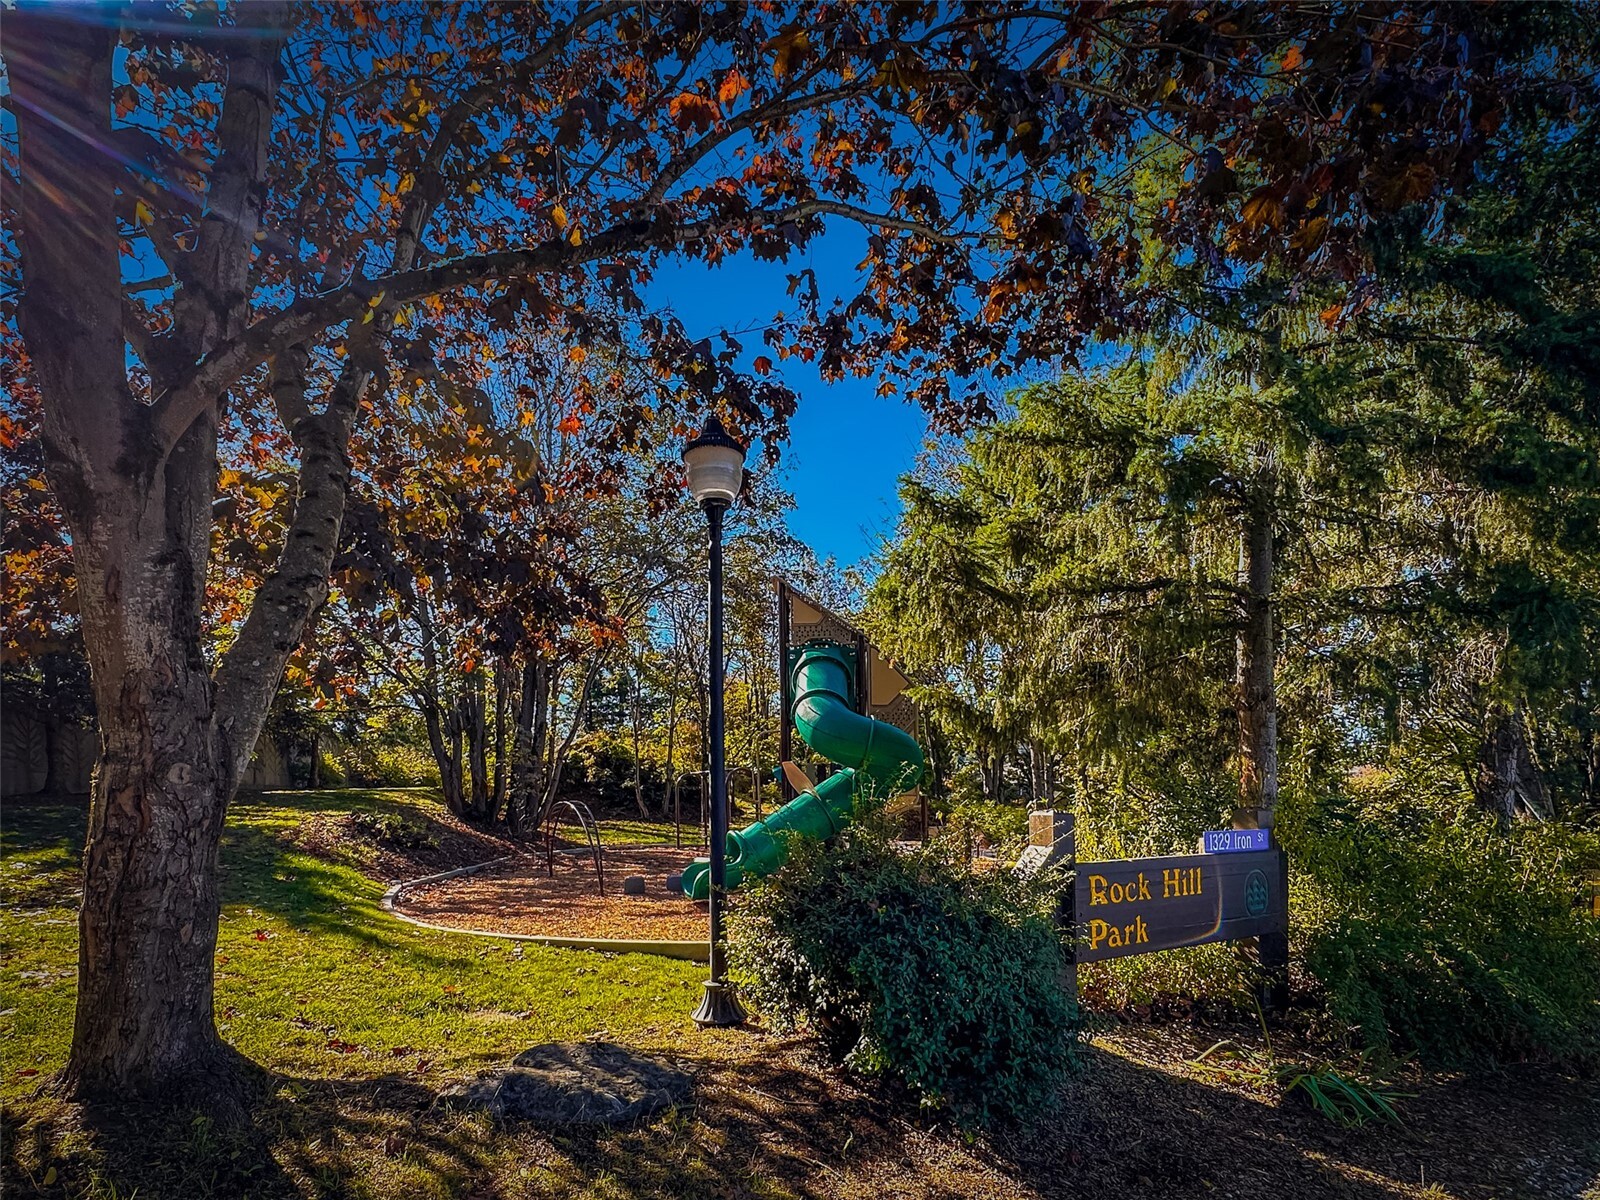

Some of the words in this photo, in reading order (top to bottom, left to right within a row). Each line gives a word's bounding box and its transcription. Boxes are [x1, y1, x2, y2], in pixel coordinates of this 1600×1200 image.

[1209, 833, 1231, 851] 1329
[1234, 833, 1252, 849] Iron
[1257, 832, 1264, 842] St
[1088, 872, 1152, 906] Rock
[1162, 866, 1203, 898] Hill
[1089, 915, 1149, 950] Park
